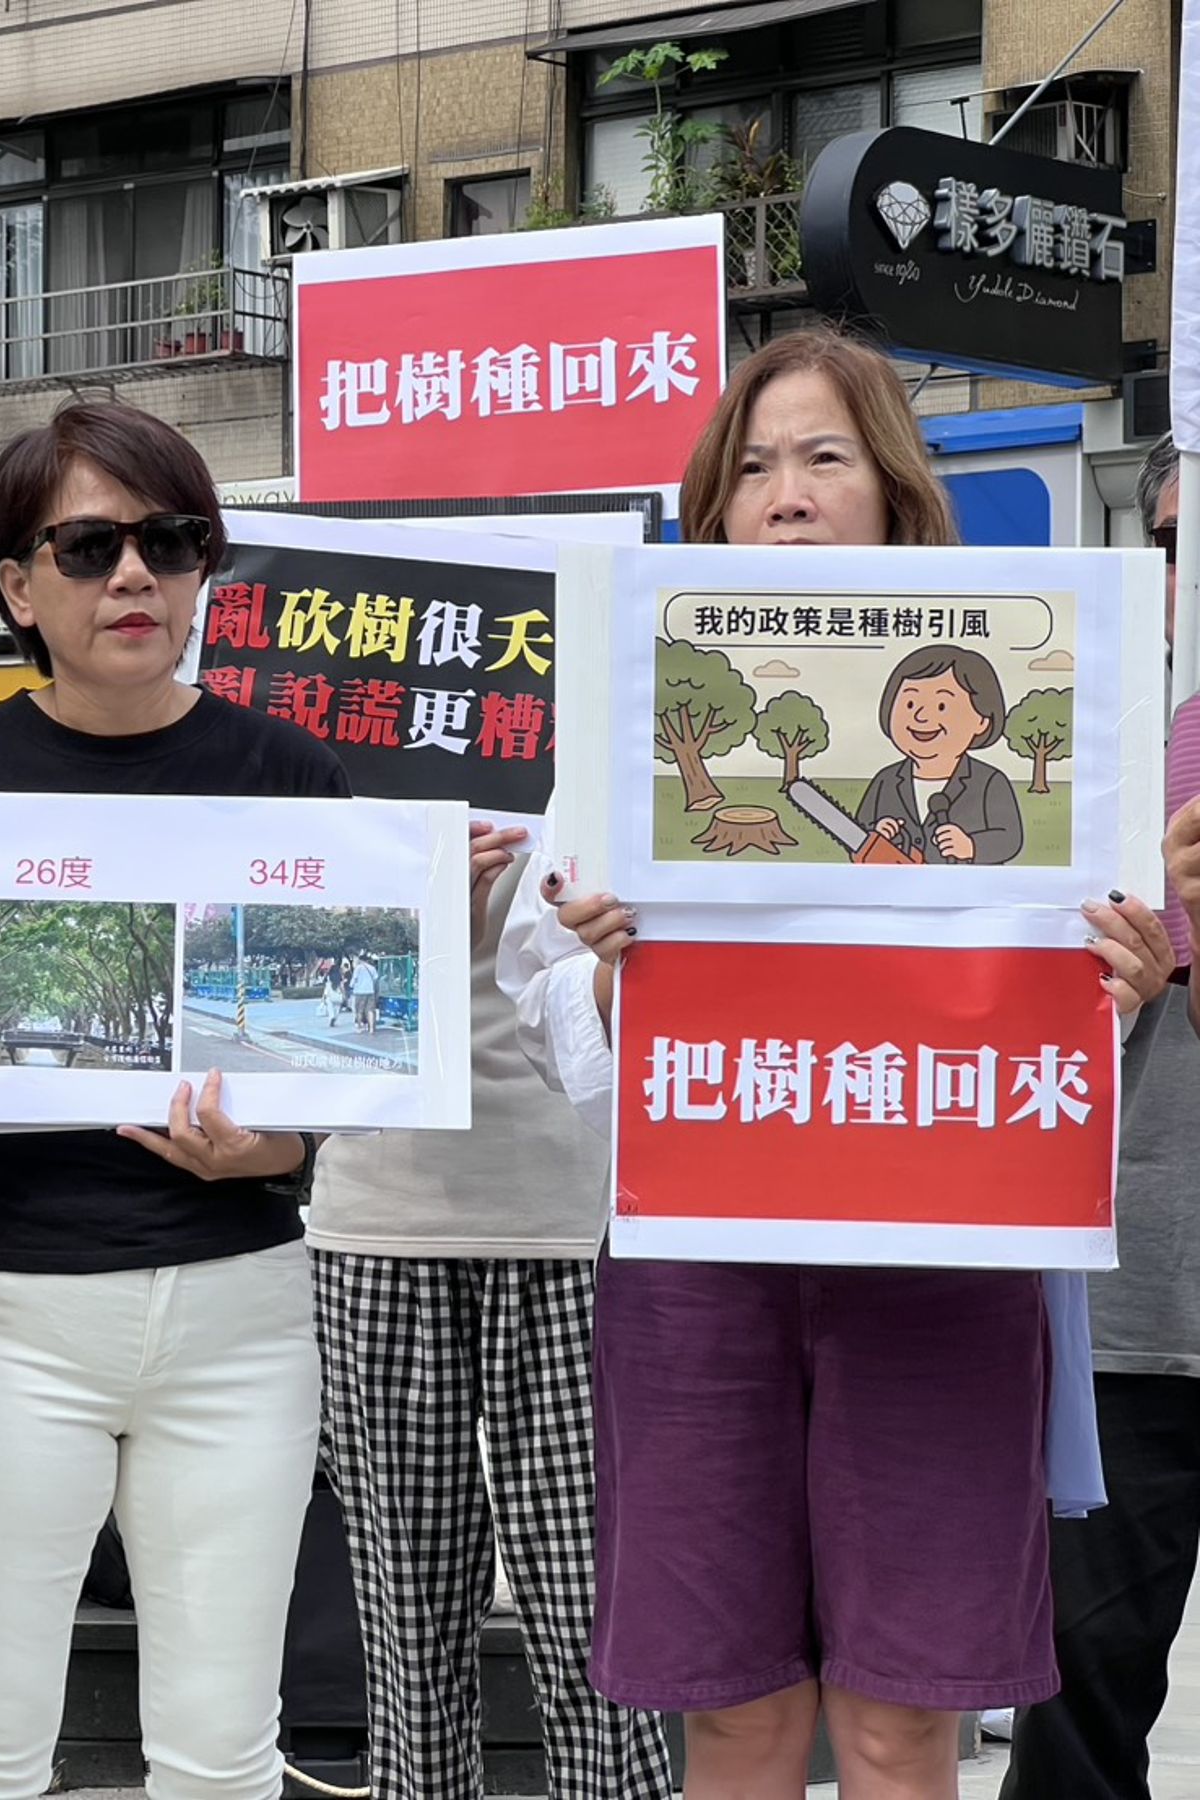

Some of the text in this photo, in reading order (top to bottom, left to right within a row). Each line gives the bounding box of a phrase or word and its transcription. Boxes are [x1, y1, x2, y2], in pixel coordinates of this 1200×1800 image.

[934, 176, 1127, 283] 樣多儷鑽石
[319, 331, 700, 431] 把樹種回來
[205, 582, 555, 676] 亂砍樹很夭
[694, 605, 991, 638] 我的政策是種樹引風
[15, 856, 93, 889] 26度
[248, 856, 326, 890] 34度
[643, 1035, 1093, 1130] 把樹種回來
